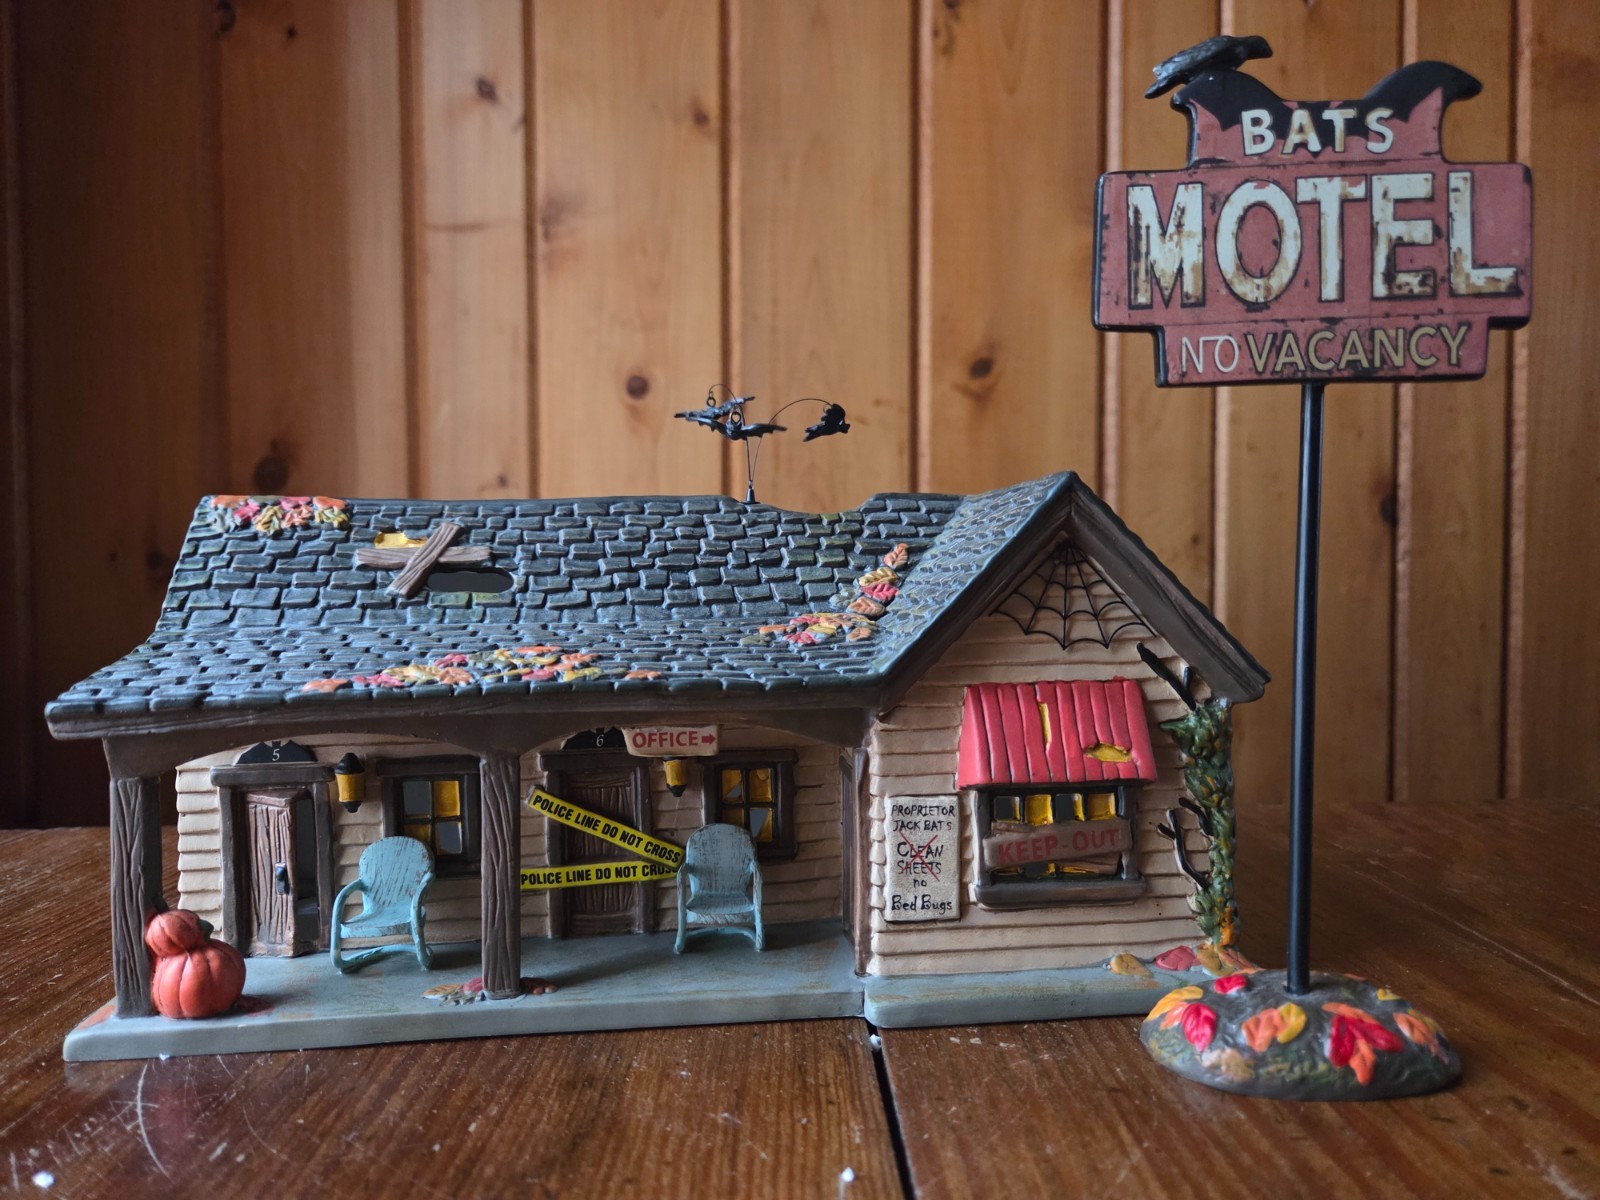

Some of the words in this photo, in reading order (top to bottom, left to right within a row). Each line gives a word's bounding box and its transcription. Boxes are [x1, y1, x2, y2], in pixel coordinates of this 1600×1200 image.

[1241, 107, 1394, 156] BATS
[1127, 171, 1522, 309] MOTEL
[1181, 334, 1240, 373] NO
[1245, 324, 1470, 373] VACANCY
[595, 733, 605, 747] 6
[632, 731, 698, 748] OFFICE
[271, 748, 281, 761] 5
[891, 804, 956, 817] PROPRIETOR
[532, 795, 574, 821] POLICE
[574, 812, 601, 831] LINE
[601, 823, 619, 839] DO
[619, 830, 643, 848] NOT
[643, 841, 681, 863] CROSS
[892, 820, 921, 832] JACK
[897, 842, 944, 859] CLEAN
[520, 872, 562, 885] POLICE
[566, 868, 592, 883] LINE
[595, 867, 611, 880] DO
[615, 865, 638, 879] NOT
[897, 860, 942, 875] SHEETS
[913, 878, 928, 888] no
[891, 895, 918, 912] Bed
[920, 894, 952, 914] Bugs
